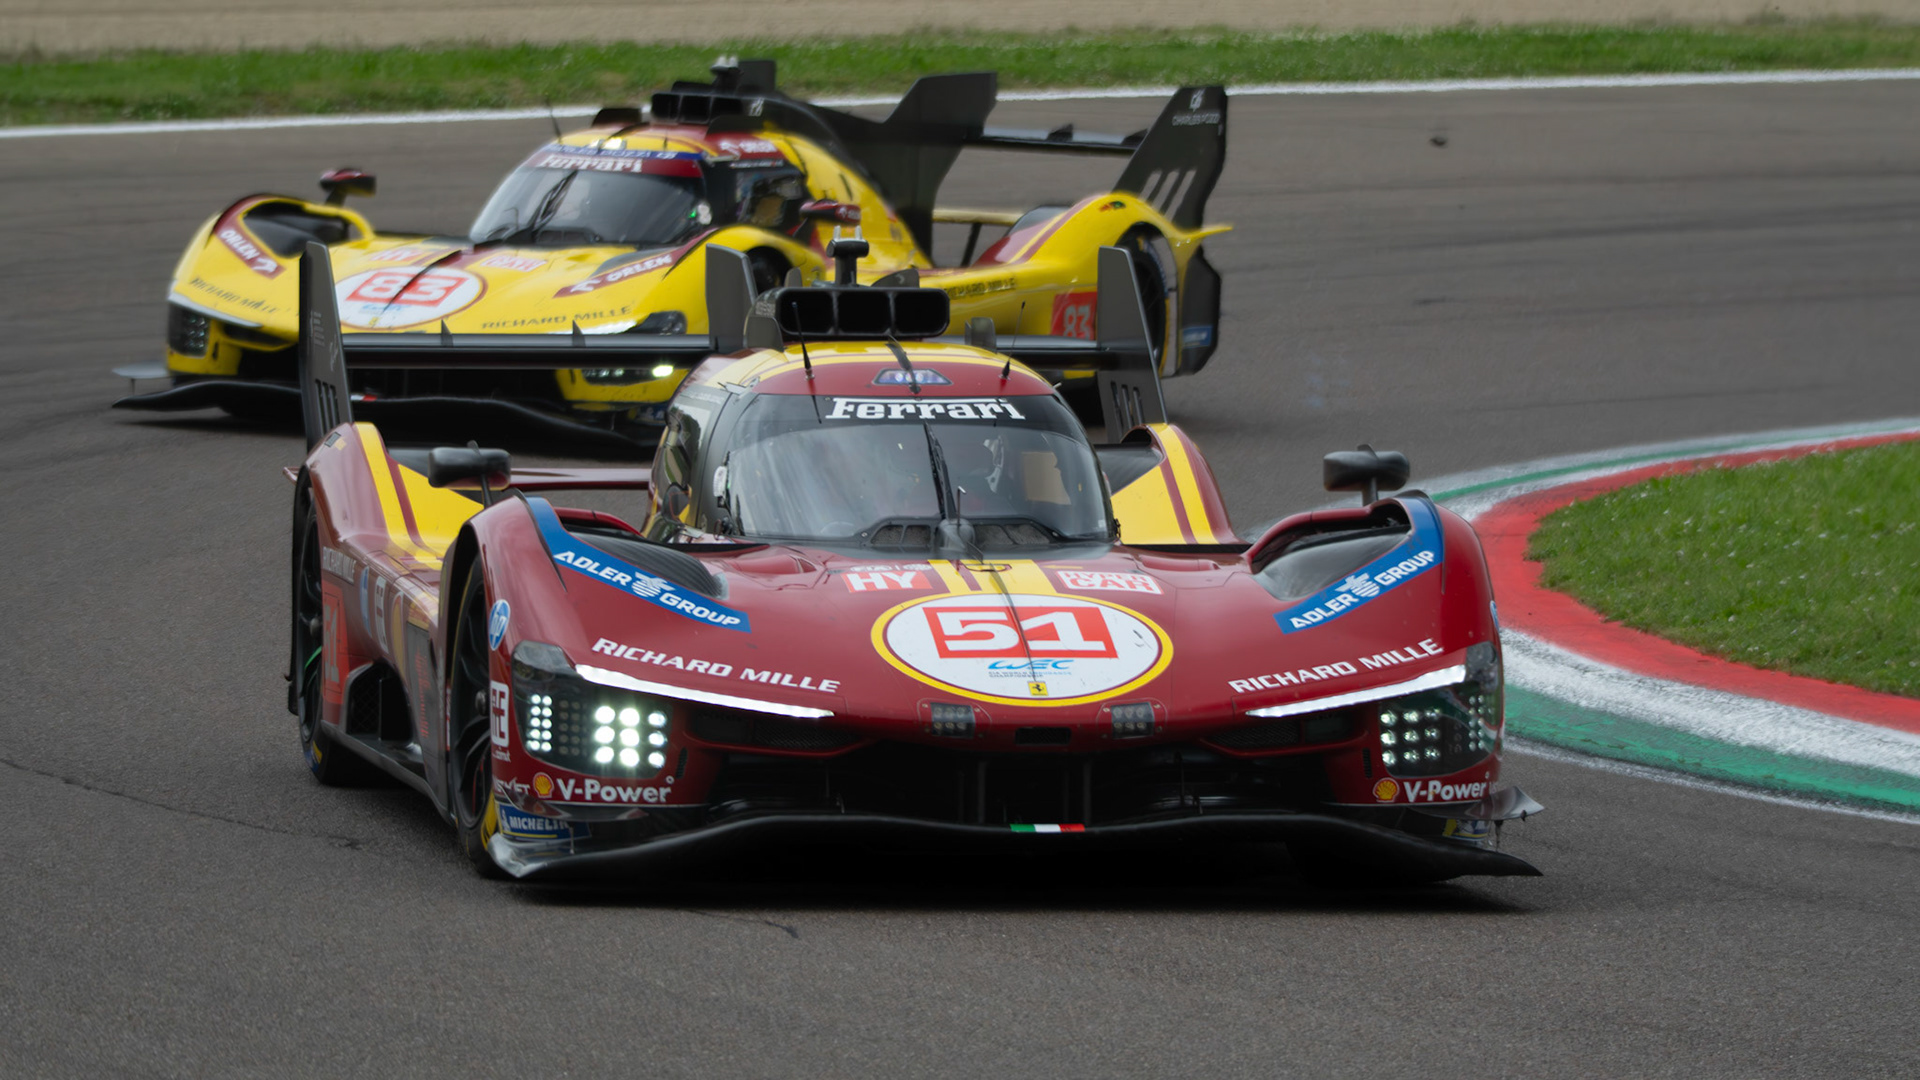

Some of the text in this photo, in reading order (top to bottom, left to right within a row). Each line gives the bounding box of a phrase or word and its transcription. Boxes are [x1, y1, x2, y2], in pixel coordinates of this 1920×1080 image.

[539, 154, 642, 173] Ferrari
[220, 229, 260, 268] ORLEN
[606, 254, 672, 282] ORLEN
[358, 273, 454, 301] 83
[482, 305, 632, 329] RICHARD MILLE
[1063, 304, 1092, 341] 83
[825, 398, 1026, 420] Ferrari
[554, 551, 740, 626] ADLER GROUP
[846, 571, 917, 591] HY
[1069, 579, 1155, 591] CAR
[1290, 550, 1435, 629] ADLER GROUP
[936, 611, 1107, 651] 51
[592, 638, 841, 693] RICHARD MILLE
[988, 659, 1074, 670] WEC
[1229, 638, 1444, 693] RICHARD MILLE
[556, 778, 672, 803] V-Power
[1403, 780, 1487, 803] V-Power
